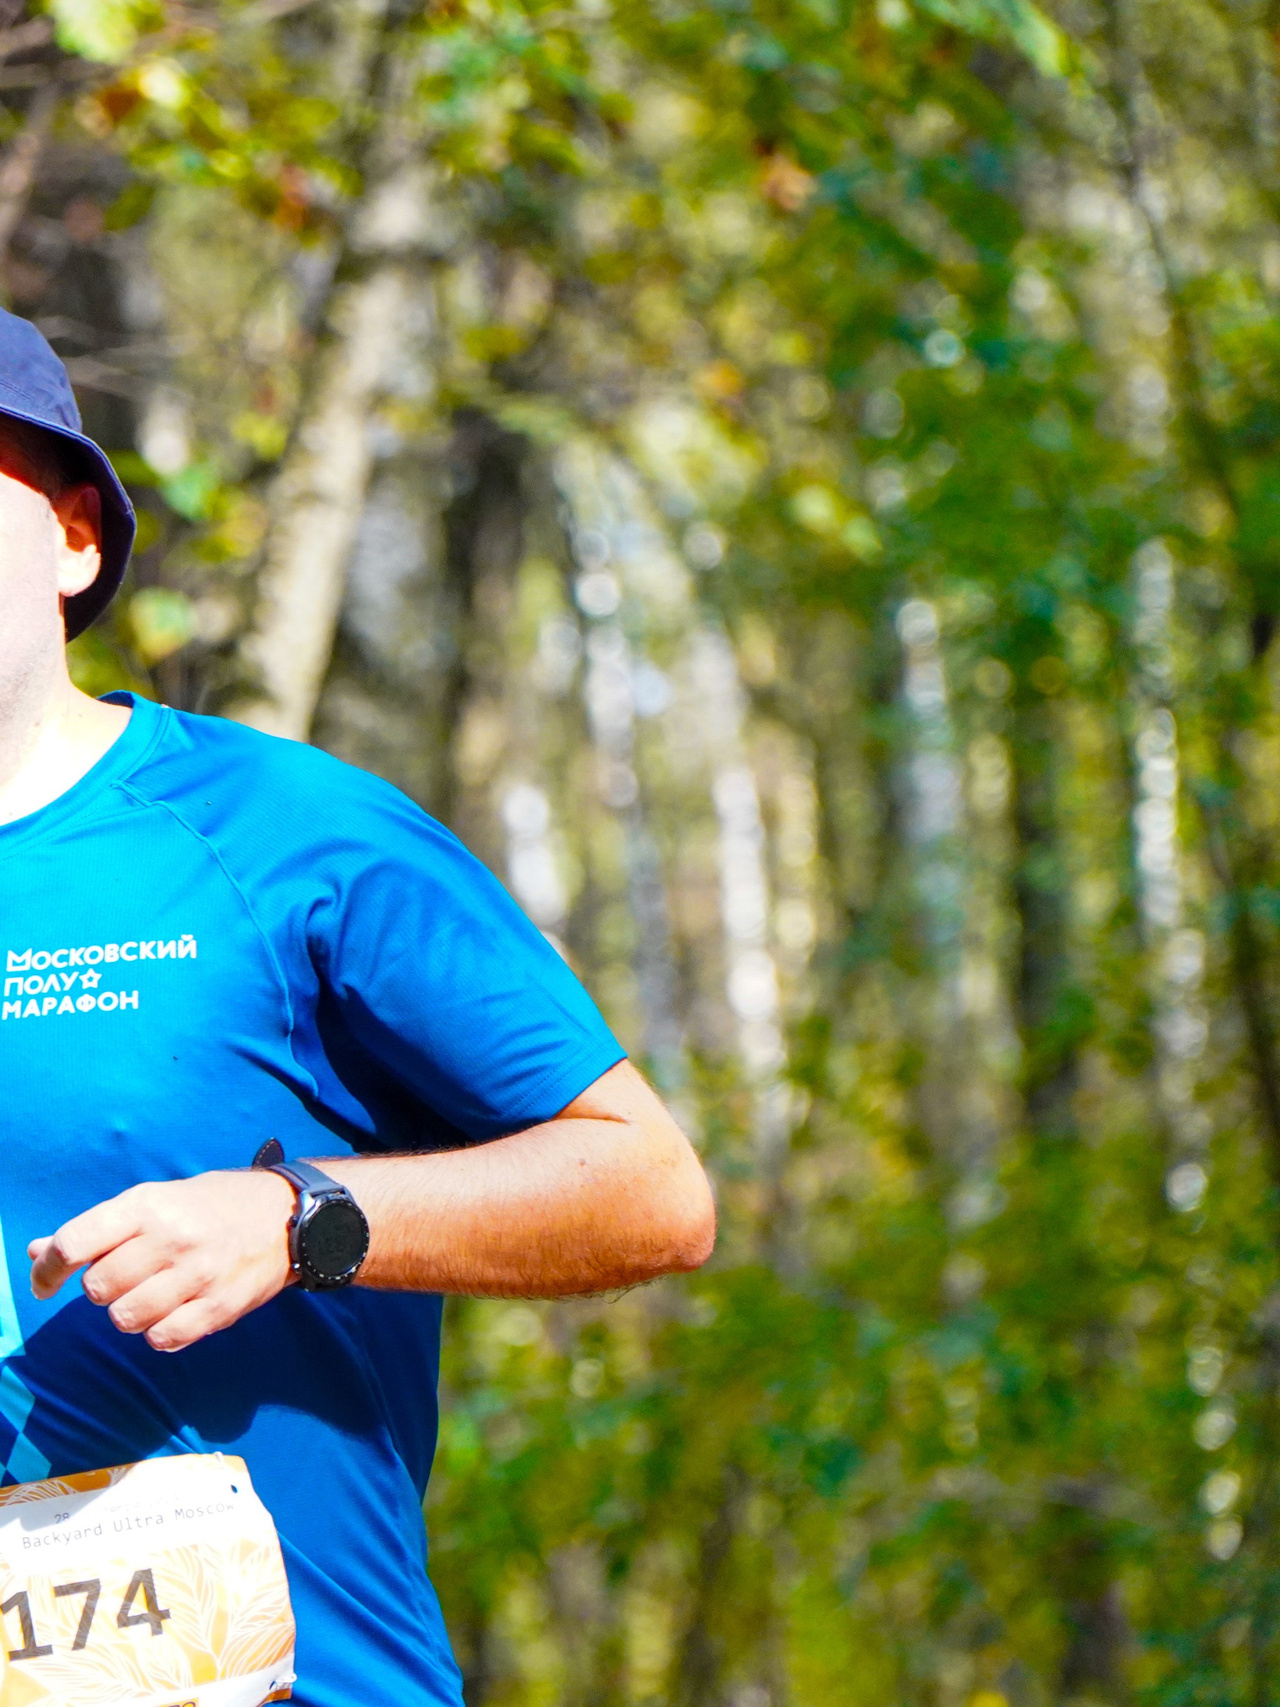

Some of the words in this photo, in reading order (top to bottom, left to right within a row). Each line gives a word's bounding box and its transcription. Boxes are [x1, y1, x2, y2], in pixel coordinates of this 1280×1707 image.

[1, 990, 139, 1020] МАРАФОН
[22, 1523, 103, 1549] Backyard
[113, 1513, 164, 1533] Ultra
[174, 1502, 235, 1521] Moscow
[0, 1568, 171, 1662] 174
